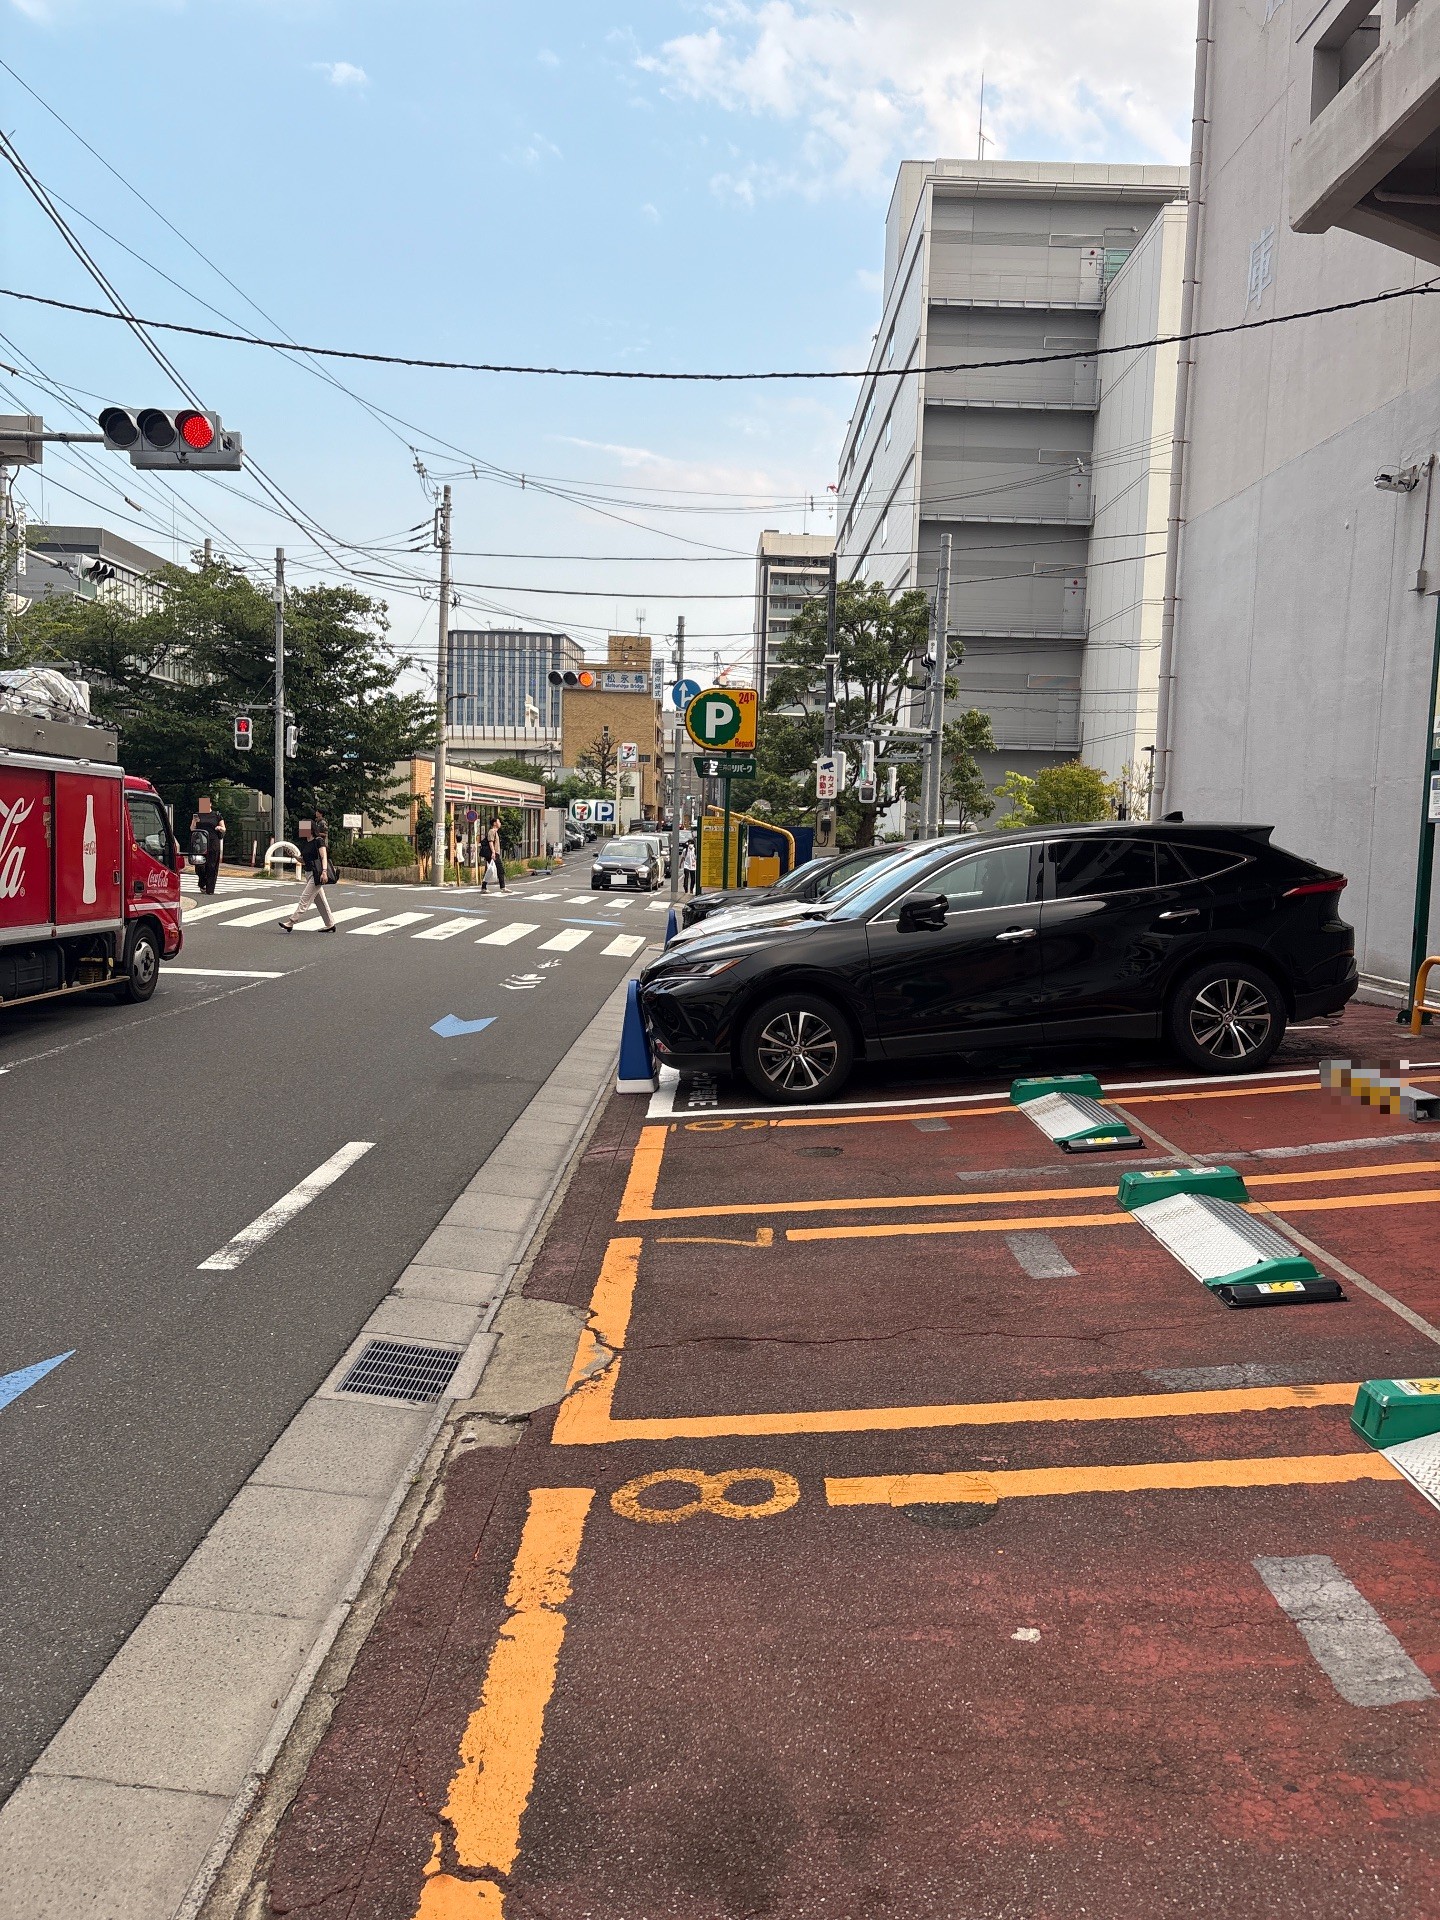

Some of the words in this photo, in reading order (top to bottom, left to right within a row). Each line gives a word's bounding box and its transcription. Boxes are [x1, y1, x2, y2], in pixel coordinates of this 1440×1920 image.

[606, 674, 643, 684] 松永橋
[705, 701, 734, 739] P
[734, 738, 754, 748] Repark
[819, 774, 827, 797] 作動中
[610, 1467, 801, 1524] 8
